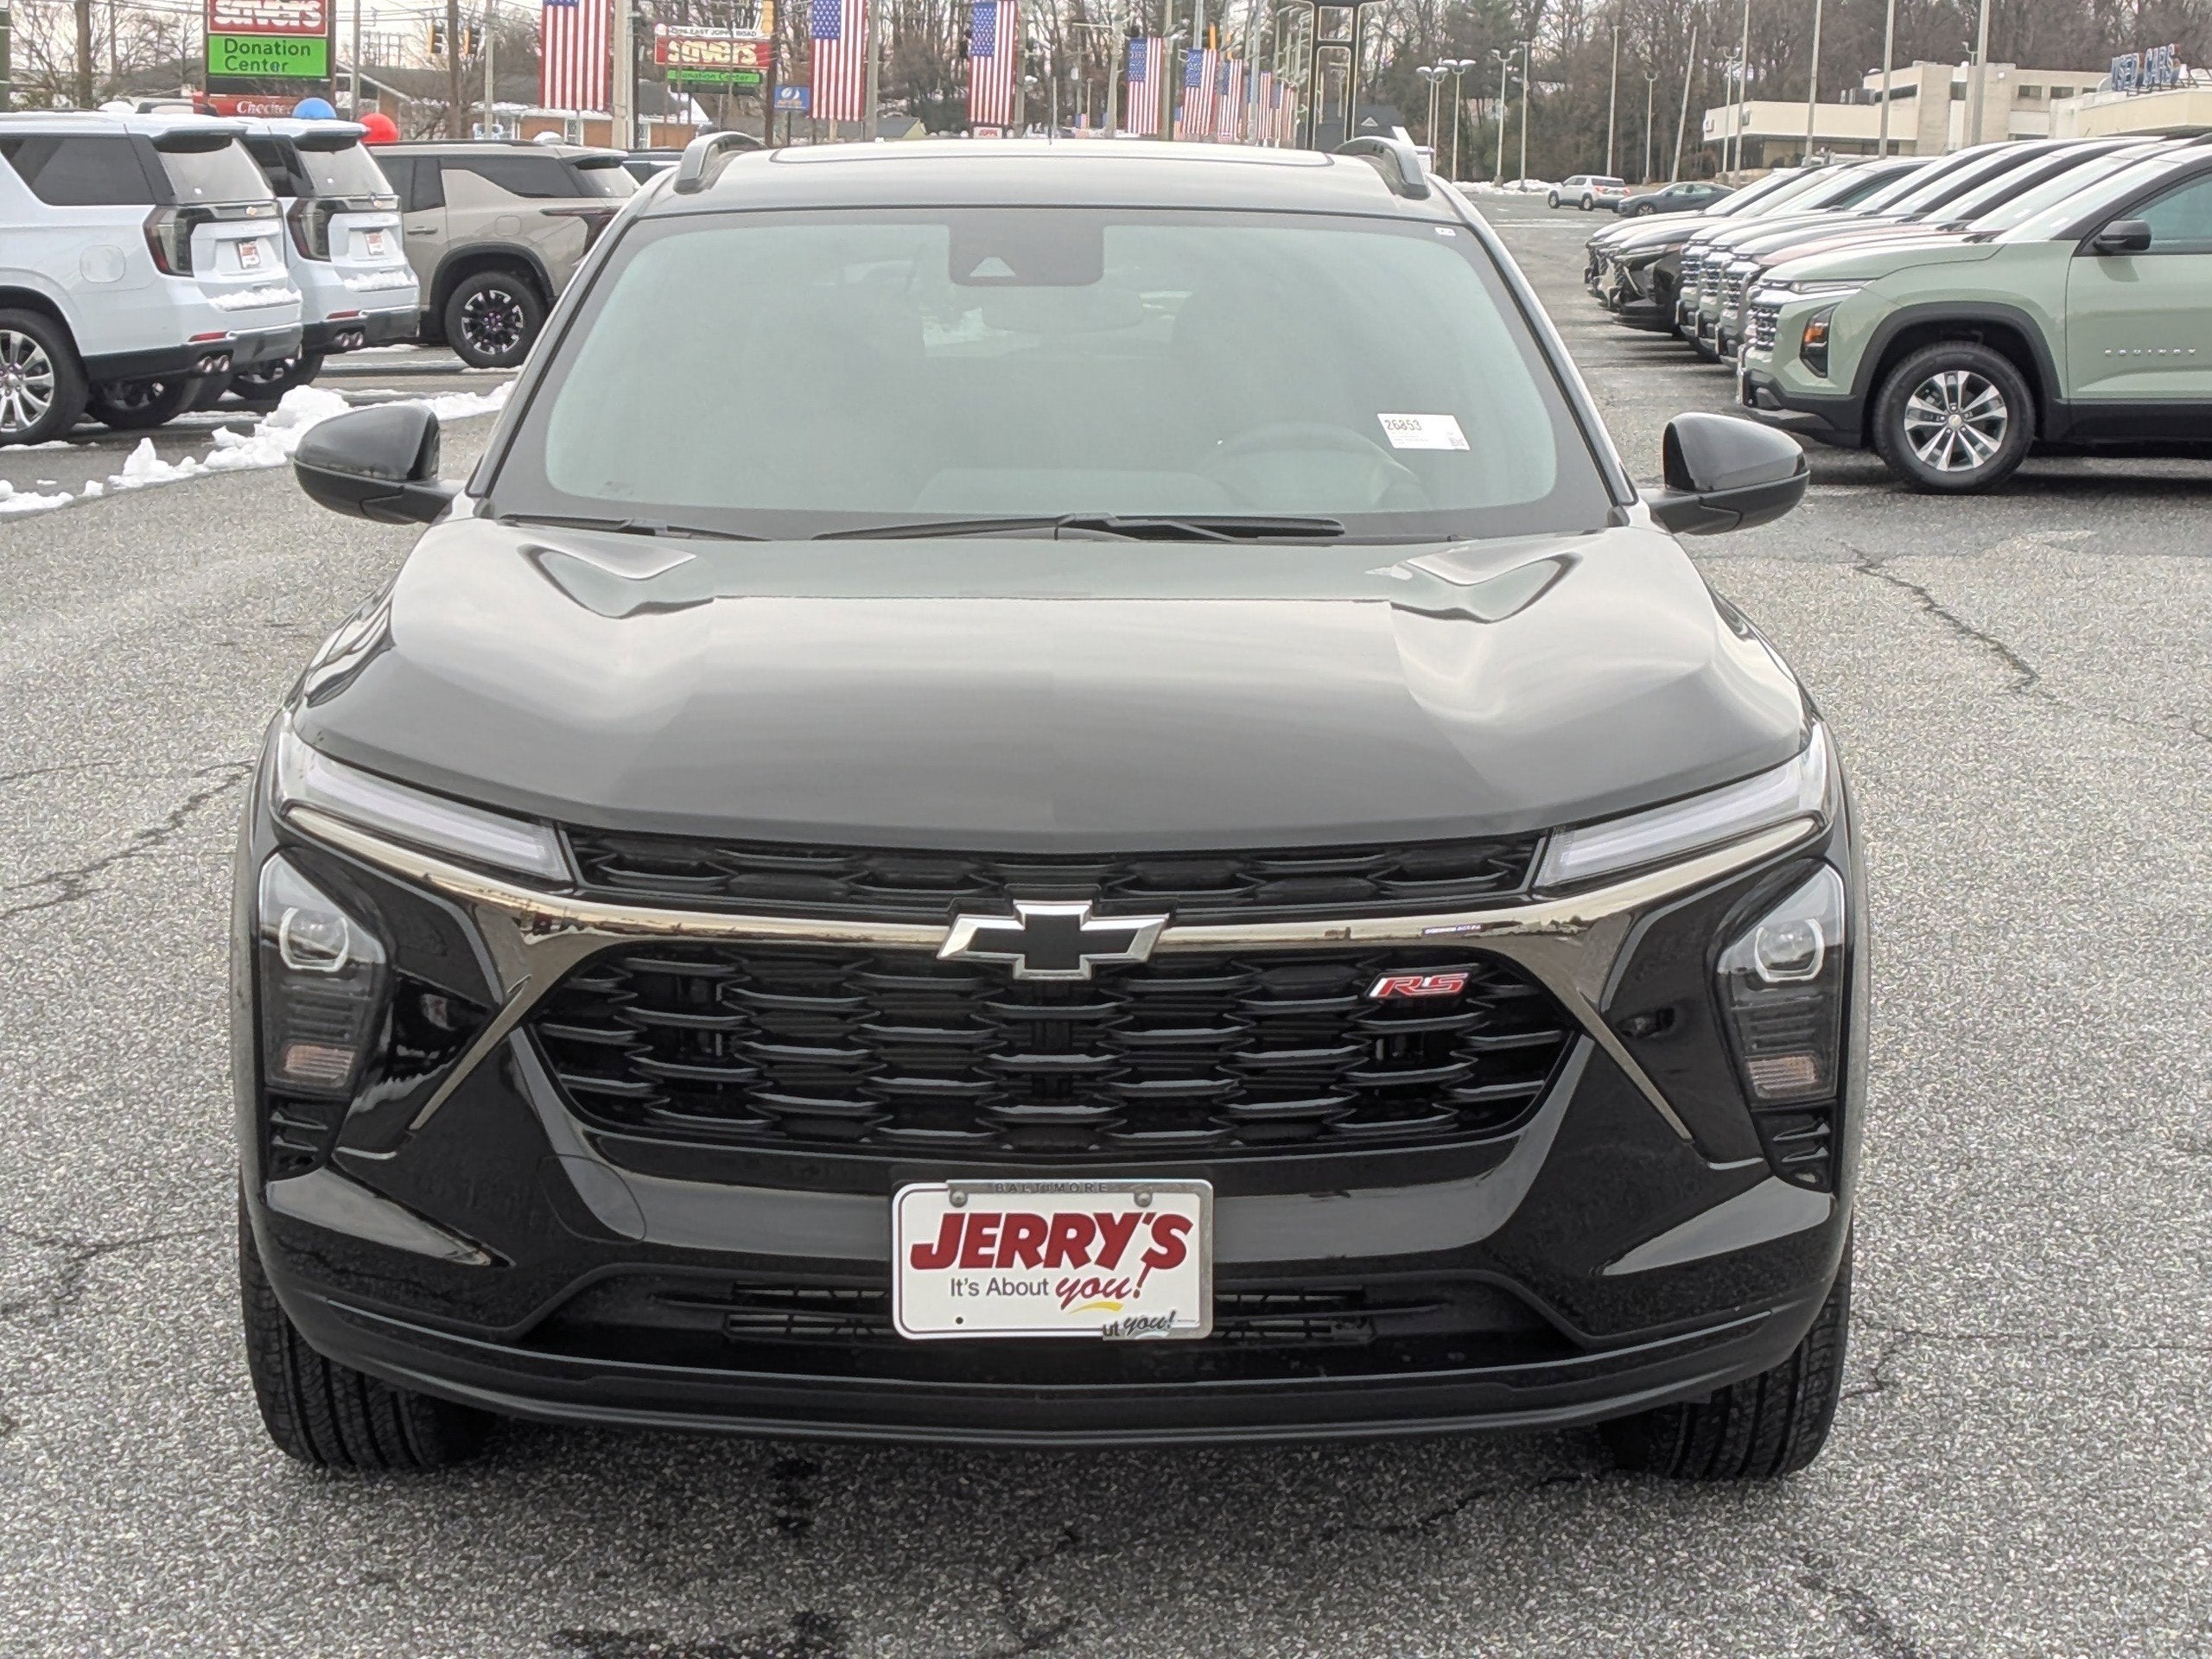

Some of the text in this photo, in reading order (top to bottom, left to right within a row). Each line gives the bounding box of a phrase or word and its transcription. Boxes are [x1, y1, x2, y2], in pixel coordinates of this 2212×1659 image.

[224, 38, 311, 56] Donation
[225, 55, 289, 73] Center
[1384, 419, 1422, 431] 26853
[1370, 972, 1469, 997] RS
[995, 1183, 1109, 1192] BALTIMORE
[910, 1212, 1194, 1270] JERRY'S
[951, 1265, 1152, 1310] It's About you!
[1123, 1310, 1176, 1336] you!
